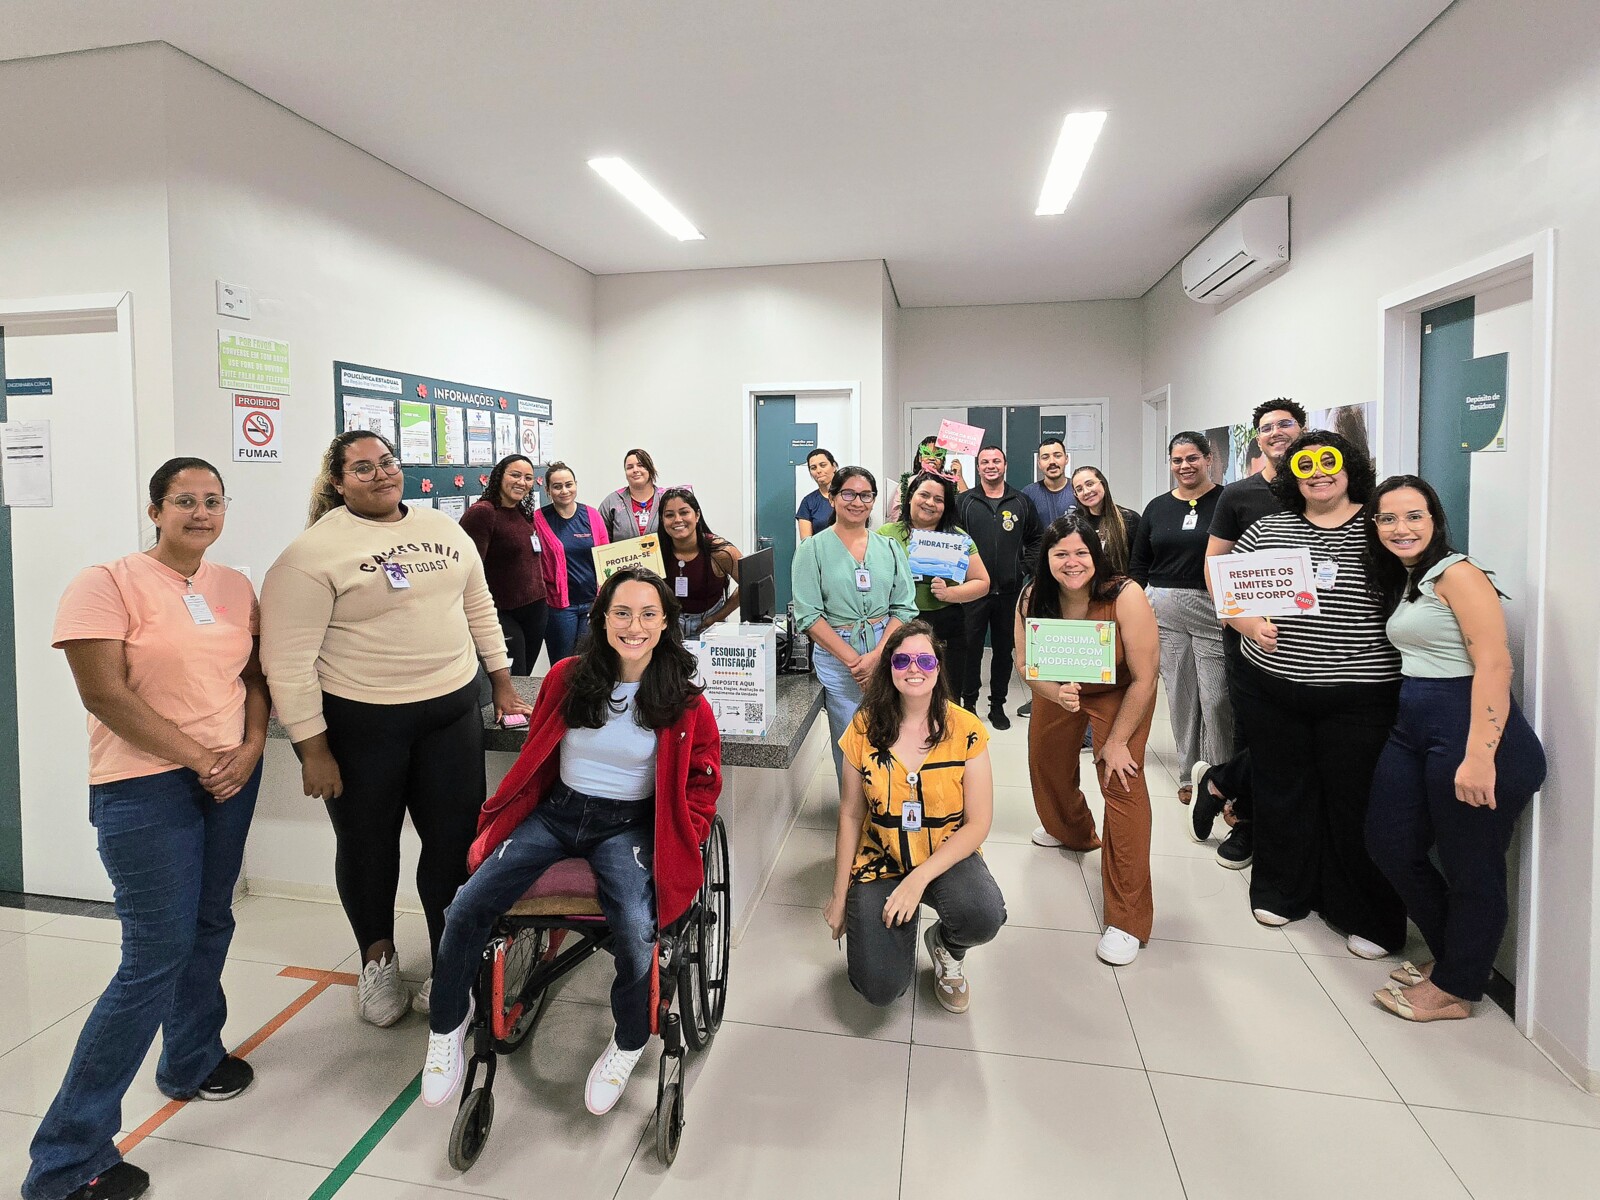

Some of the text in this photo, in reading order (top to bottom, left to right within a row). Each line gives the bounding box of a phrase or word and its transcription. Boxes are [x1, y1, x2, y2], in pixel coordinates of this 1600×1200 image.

[239, 337, 272, 350] POR FAVOR
[251, 350, 259, 358] EM
[261, 352, 272, 360] TOM
[241, 361, 254, 369] FONE
[344, 372, 399, 386] POLICLÍNICA ESTADUAL
[239, 397, 278, 407] PROIBIDO
[434, 388, 494, 407] INFORMAÇÕES
[1466, 394, 1491, 404] Depósito
[1470, 402, 1495, 410] Resíduos
[239, 449, 278, 458] FUMAR
[919, 540, 962, 551] HIDRATE-SE
[360, 543, 459, 573] CALIFORNIA
[606, 551, 650, 566] PROTEJA-SE
[415, 560, 448, 573] COAST
[1229, 568, 1276, 579] RESPEITE
[1234, 579, 1292, 590] LIMITES DO
[1234, 590, 1295, 600] SEU CORPO
[1297, 596, 1313, 606] PARE
[1045, 635, 1095, 644] CONSUMA
[710, 647, 756, 658] PESQUISA DE
[712, 657, 755, 670] SATISFAÇÃO
